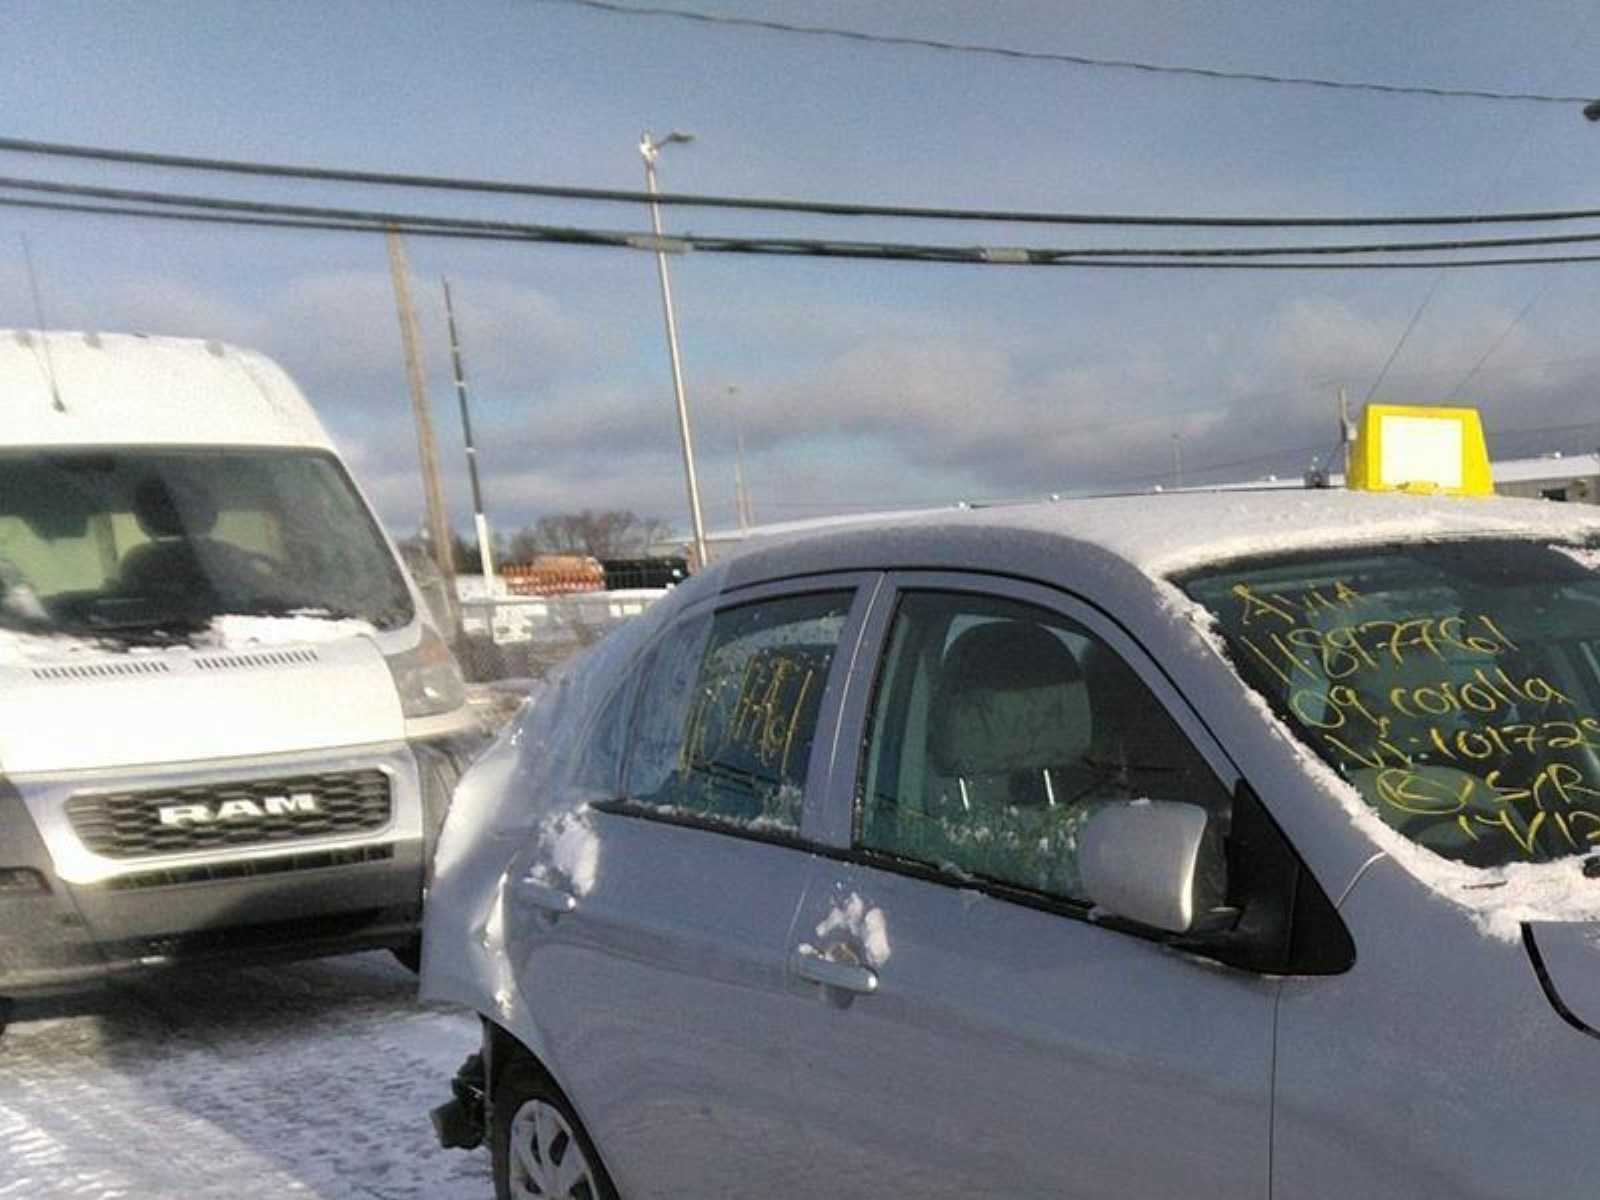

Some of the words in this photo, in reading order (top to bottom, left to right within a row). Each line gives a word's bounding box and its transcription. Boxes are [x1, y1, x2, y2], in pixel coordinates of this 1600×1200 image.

[1239, 614, 1520, 686] 11897761
[1291, 685, 1381, 728] 09
[158, 793, 316, 827] RAM
